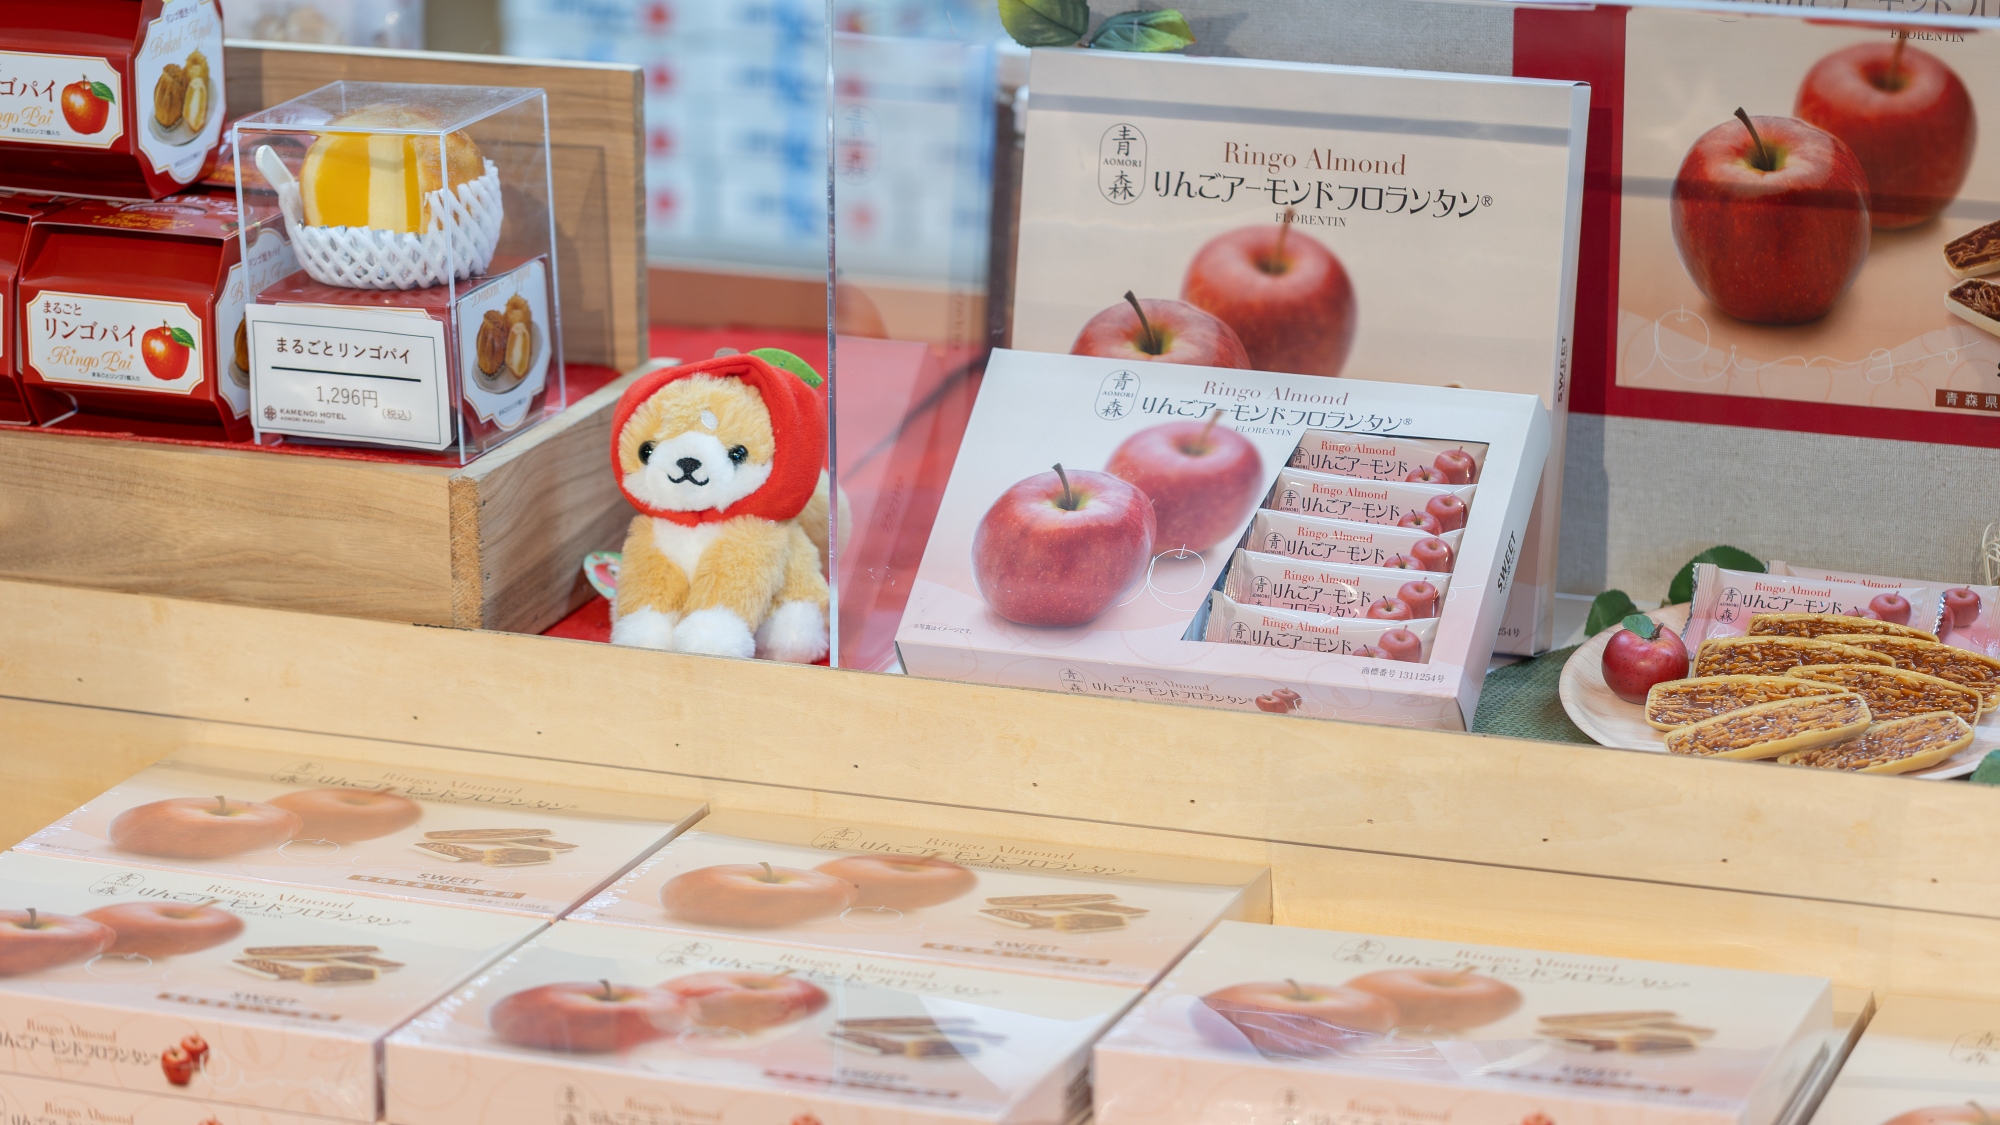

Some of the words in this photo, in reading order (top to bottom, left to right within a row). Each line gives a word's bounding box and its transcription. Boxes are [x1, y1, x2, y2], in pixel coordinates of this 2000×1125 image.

[0, 77, 55, 102] ゴパイ
[1112, 125, 1137, 156] 青
[1103, 158, 1142, 168] AOMORI
[1222, 141, 1297, 174] Ringo
[1304, 147, 1407, 176] Almond
[1108, 170, 1135, 200] 森
[1275, 212, 1347, 227] FLORENTIN
[43, 300, 82, 316] まるごと
[44, 317, 136, 348] リンゴパイ
[276, 337, 410, 364] まるごとリンゴパイ
[47, 346, 99, 374] Ringo
[1113, 371, 1133, 390] 青
[316, 386, 378, 408] 1,296円
[1102, 390, 1134, 398] AOMORI
[1203, 380, 1261, 403] Ringo
[1265, 386, 1349, 407] Almond
[1946, 392, 1998, 409] 青森県
[280, 408, 318, 418] KAMENOI
[320, 412, 347, 420] HOTEL
[1101, 398, 1123, 418] 森
[1234, 425, 1293, 437] FLORENTIN
[1321, 440, 1351, 455] Ringo
[1353, 443, 1396, 456] Almond
[1311, 454, 1408, 476] りんごアーモンド
[1283, 491, 1296, 507] 青
[1311, 483, 1343, 498] Ringo
[1345, 487, 1388, 500] Almond
[1301, 497, 1400, 520] りんごアーモンド
[1269, 534, 1281, 549] 青
[1297, 526, 1328, 541] Ringo
[1331, 530, 1373, 544] Almond
[1286, 540, 1385, 564] りんごアーモンド
[1498, 530, 1516, 594] SWEET
[1254, 577, 1268, 593] 青
[1283, 569, 1315, 584] Ringo
[1316, 573, 1360, 587] Almond
[1273, 583, 1371, 606] りんごアーモンド
[1725, 588, 1737, 602] 青
[1754, 581, 1786, 595] Ringo
[1788, 585, 1832, 598] Almond
[1742, 594, 1843, 615] りんごアーモンド
[1719, 608, 1733, 622] 森
[1233, 623, 1246, 640] 青
[1262, 616, 1294, 632] Ringo
[1296, 622, 1340, 635] Almond
[1252, 630, 1352, 655] りんごアーモンド
[1064, 668, 1077, 679] 青
[1361, 666, 1397, 678] 商標番号
[1398, 670, 1446, 683] 1311254号
[1121, 675, 1158, 688] Ringo
[1161, 679, 1210, 692] Almond
[381, 772, 444, 787] Ringo
[448, 778, 524, 796] Almond
[925, 836, 987, 850] Ringo
[997, 845, 1075, 861] Almond
[416, 872, 484, 885] SWEET
[206, 884, 265, 901] Ringo
[275, 892, 354, 910] Almond
